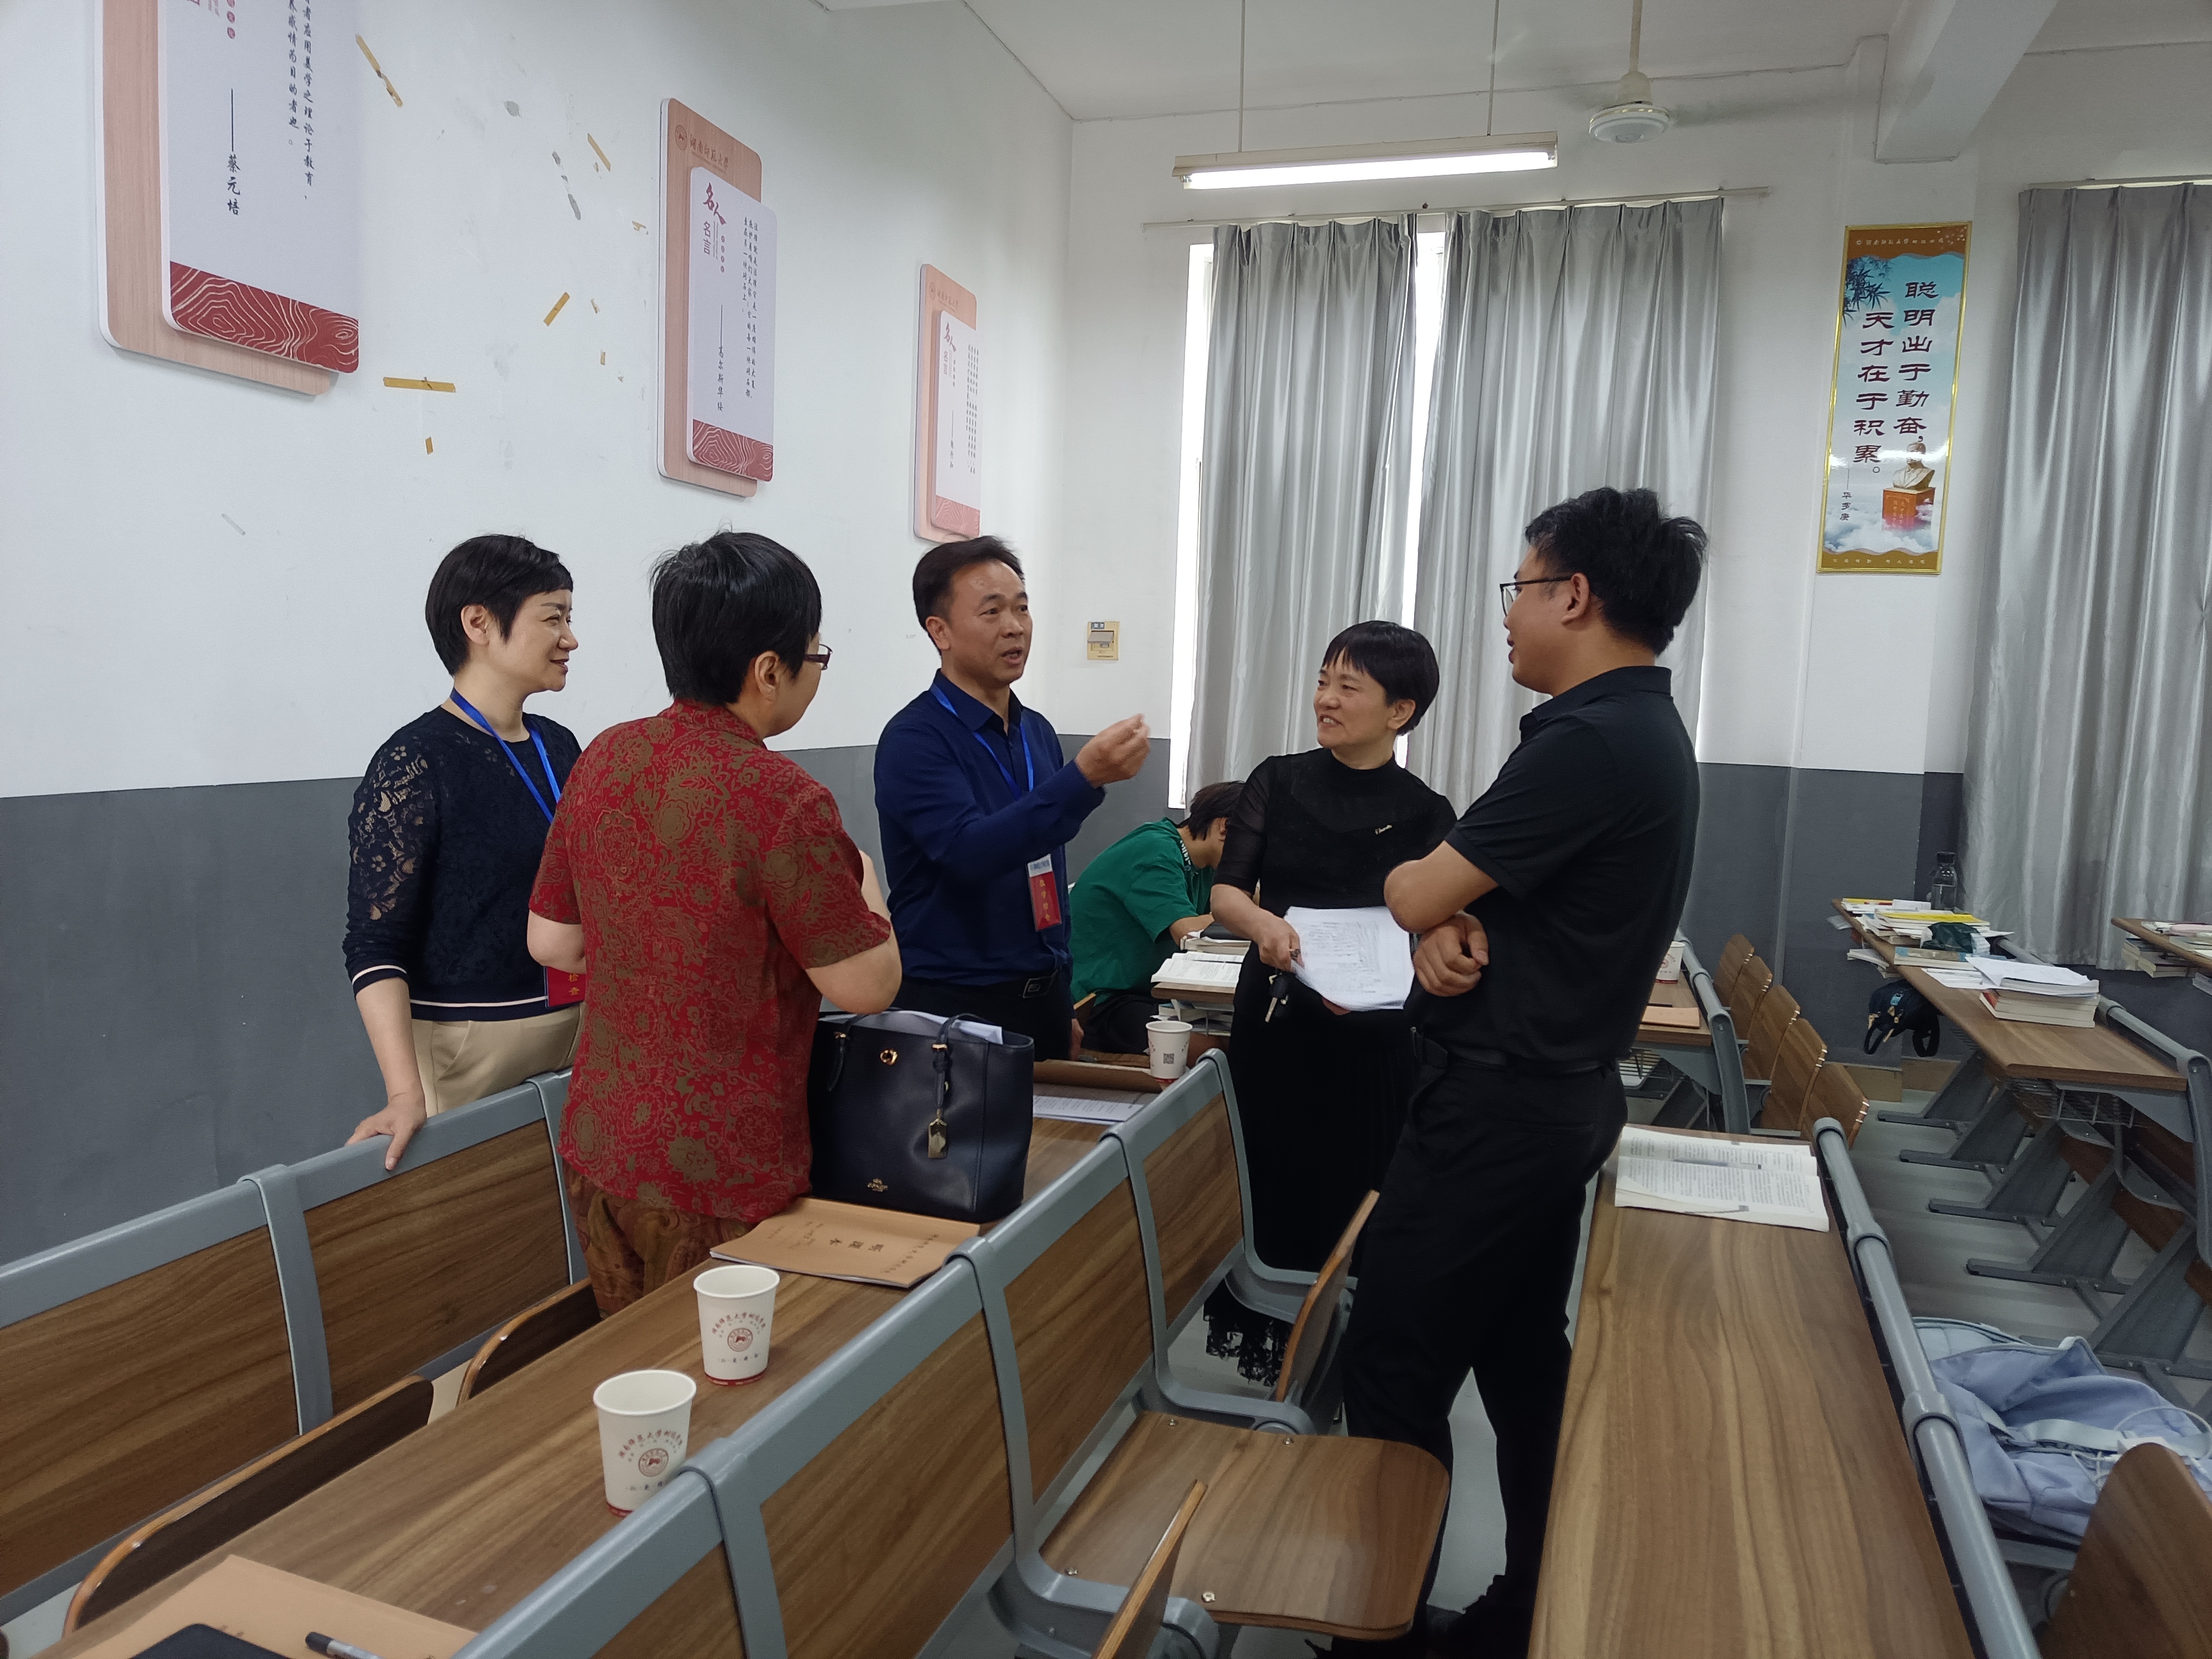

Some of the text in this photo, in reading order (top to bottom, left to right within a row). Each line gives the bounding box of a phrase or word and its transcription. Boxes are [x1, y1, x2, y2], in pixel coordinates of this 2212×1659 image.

[302, 0, 314, 200] 者应用美学之理论于教育，
[703, 221, 711, 255] 名言
[1853, 311, 1895, 473] 天才在于积累。
[1893, 281, 1939, 442] 聪明出于勤奋，
